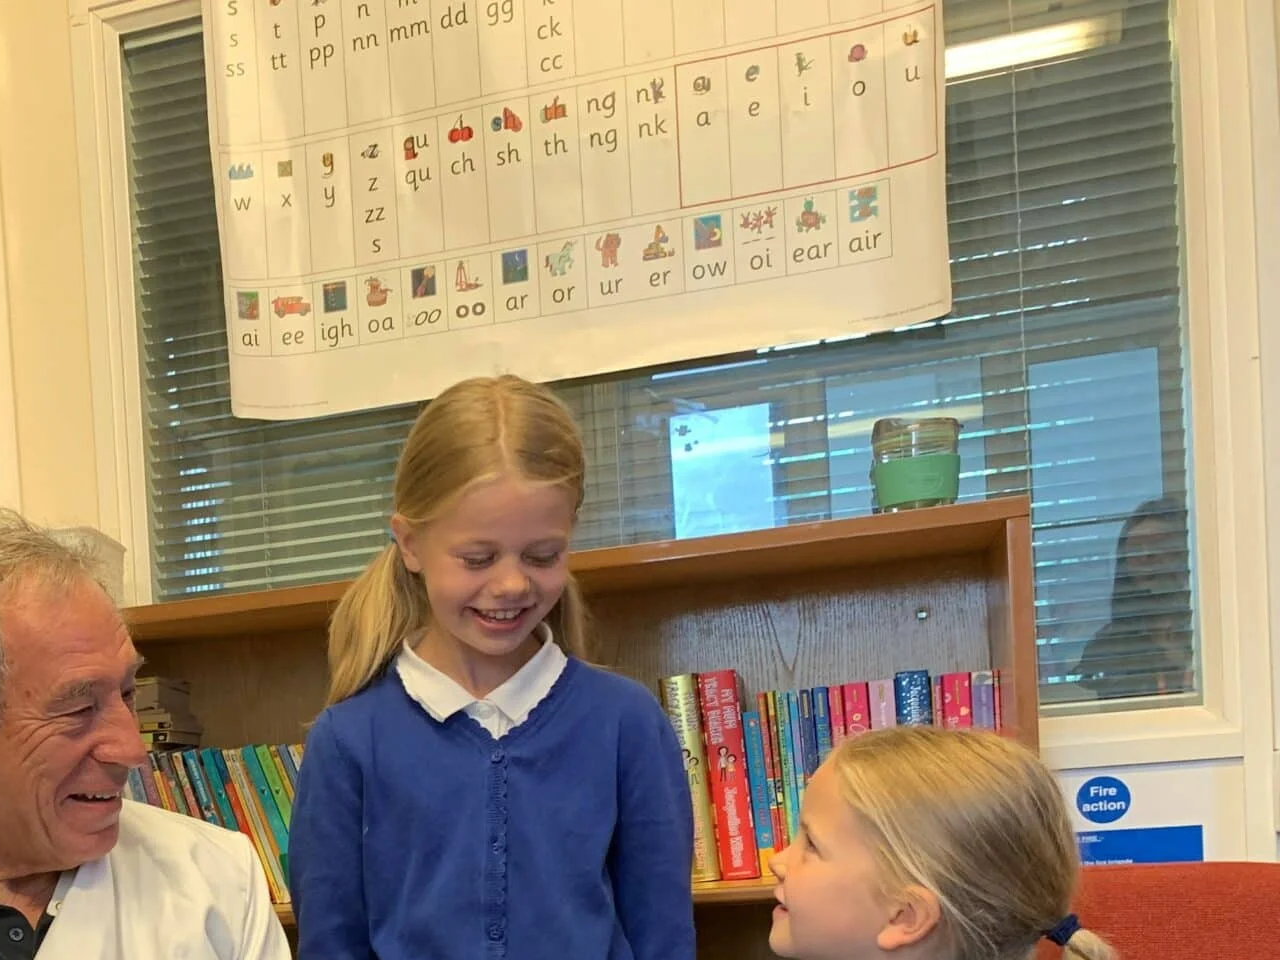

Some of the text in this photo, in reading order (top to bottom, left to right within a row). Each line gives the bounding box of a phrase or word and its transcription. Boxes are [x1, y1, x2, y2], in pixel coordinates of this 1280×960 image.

[357, 0, 514, 29] n dd gg
[229, 14, 562, 52] s t p nn mm ck
[226, 44, 563, 77] ss tt pp cc
[587, 91, 616, 118] ng
[234, 197, 252, 211] w
[281, 194, 292, 208] x
[324, 186, 336, 208] y
[368, 177, 378, 191] z
[405, 165, 432, 192] qu
[451, 153, 476, 176] ch
[497, 142, 520, 167] sh
[544, 133, 568, 158] th
[590, 128, 618, 153] ng
[638, 114, 667, 138] nk
[696, 111, 711, 127] a
[748, 101, 760, 117] e
[852, 80, 866, 97] o
[905, 65, 920, 82] u
[365, 207, 385, 224] zz
[372, 239, 382, 253] s
[241, 230, 882, 348] ai ee igh oa oo oo ar or ur er ow oi ear air
[1090, 785, 1117, 797] Fire
[1082, 801, 1126, 812] action
